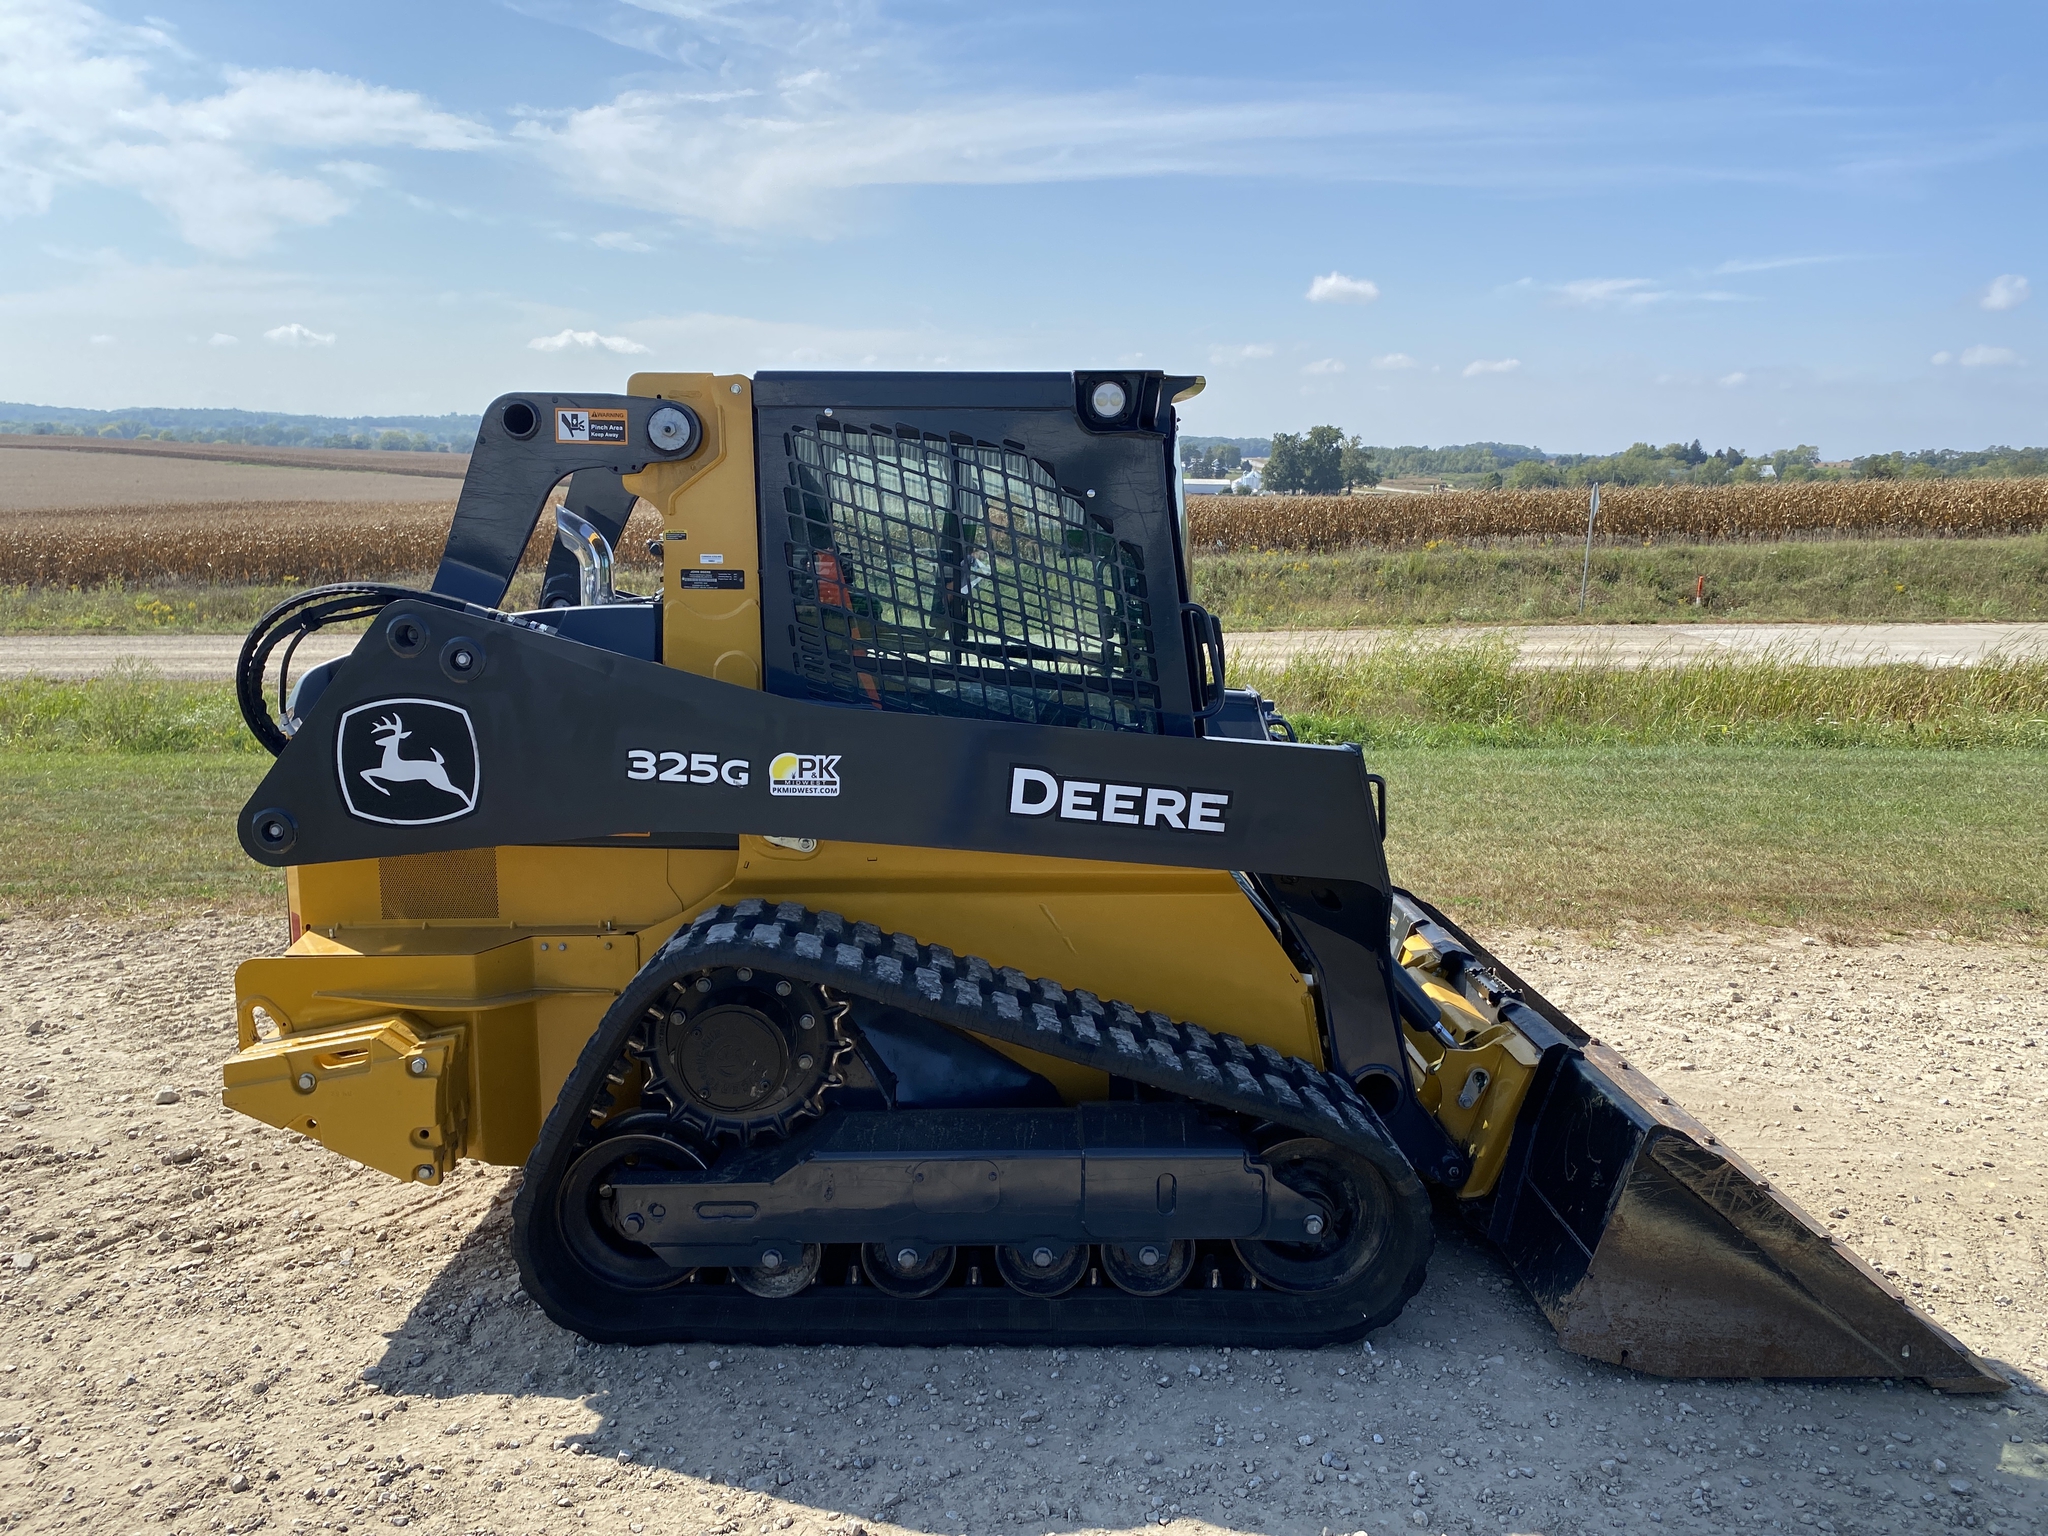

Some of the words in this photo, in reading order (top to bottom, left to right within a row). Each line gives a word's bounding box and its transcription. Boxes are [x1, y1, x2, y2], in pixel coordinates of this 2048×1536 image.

[627, 750, 749, 786] 325G
[798, 758, 836, 779] P&K
[1010, 767, 1228, 833] DEERE
